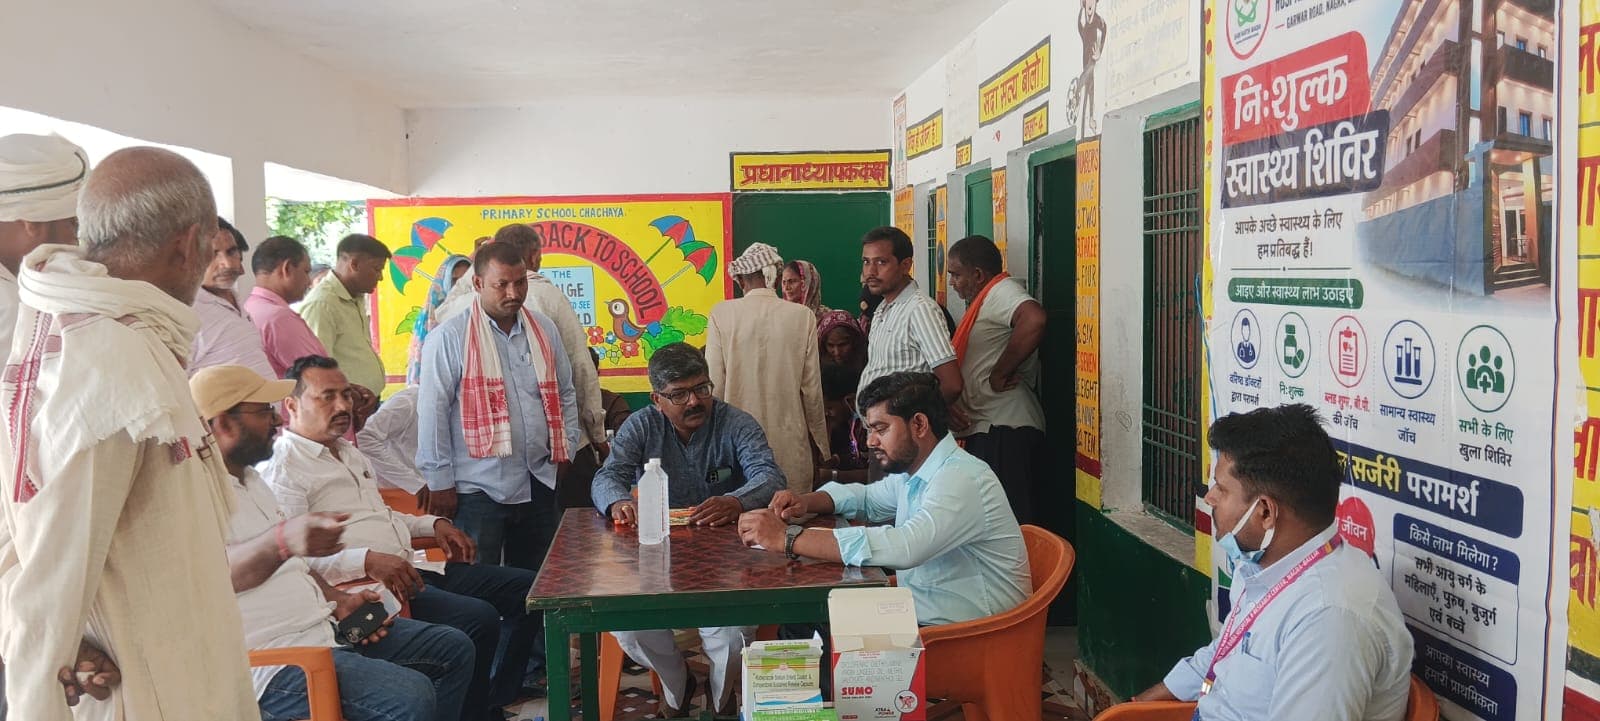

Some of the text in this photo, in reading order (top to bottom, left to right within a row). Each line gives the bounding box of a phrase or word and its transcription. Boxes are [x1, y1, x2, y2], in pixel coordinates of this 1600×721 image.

[1226, 121, 1379, 198] स्वास्थ्य शिविर
[482, 207, 624, 220] PRIMARY SCHOOL CHACHAYA
[1235, 208, 1343, 235] आपके अच्छे स्वास्थ्य के लिए
[1257, 244, 1269, 259] हम
[1270, 238, 1301, 259] प्रतिबद्ध
[552, 270, 571, 278] THE
[593, 232, 617, 262] TO
[611, 250, 662, 319] SCHOOL
[1235, 285, 1254, 298] आइए
[1256, 281, 1270, 298] और
[1272, 285, 1300, 300] स्वास्थ्य
[1302, 286, 1320, 300] लाभ
[579, 300, 591, 309] SEE
[1332, 410, 1343, 426] की
[1379, 404, 1436, 426] सामान्य स्वास्थ्य
[1458, 417, 1513, 444] सभी के लिए
[1459, 443, 1512, 467] खुला शिविर
[1351, 454, 1401, 492] सर्जरी
[1407, 470, 1479, 517] परामर्श
[1341, 516, 1368, 541] जीवन
[1409, 523, 1430, 546] किसे
[1432, 535, 1454, 555] लाभ
[1415, 557, 1487, 595] सभी आयु वर्ग के
[1429, 607, 1466, 634] एवं बच्चे
[1471, 602, 1496, 626] बुजुर्ग
[1425, 645, 1490, 688] आपका स्वास्थ्य
[841, 686, 873, 695] SUMO
[1450, 679, 1498, 715] प्राथमिकता
